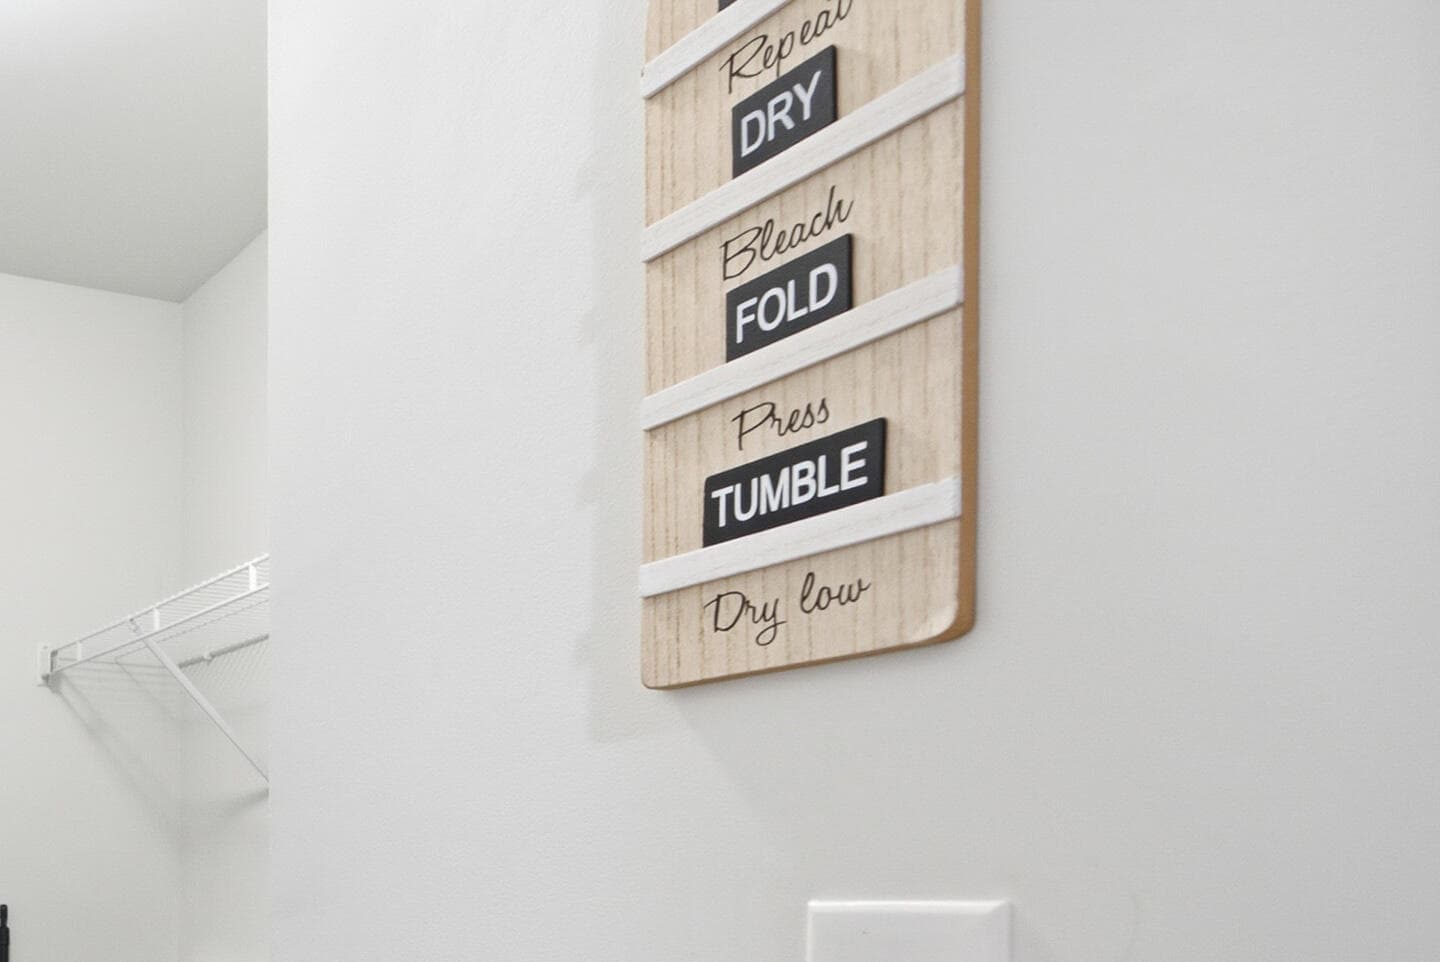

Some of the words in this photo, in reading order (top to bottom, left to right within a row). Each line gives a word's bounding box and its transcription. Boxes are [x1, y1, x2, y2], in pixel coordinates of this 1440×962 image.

[740, 70, 823, 158] DRY
[719, 185, 854, 281] Bleach
[735, 262, 839, 344] FOLD
[731, 397, 830, 450] Press
[711, 440, 868, 528] TUMBLE
[703, 591, 787, 646] Dry
[800, 572, 871, 614] low
